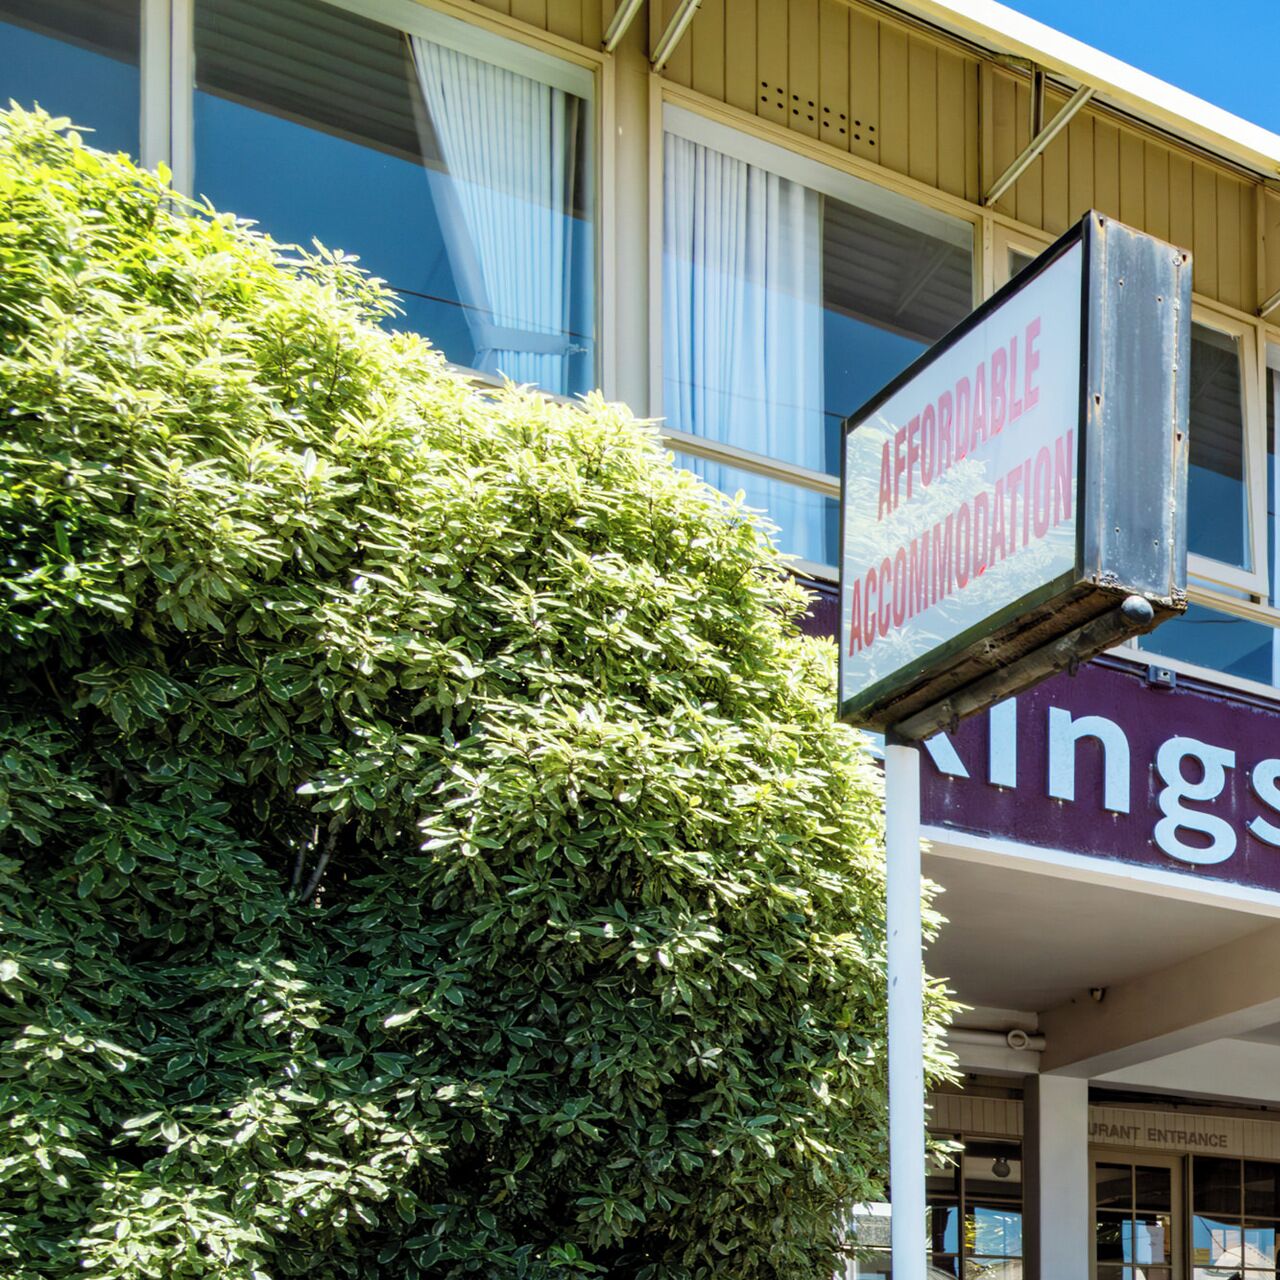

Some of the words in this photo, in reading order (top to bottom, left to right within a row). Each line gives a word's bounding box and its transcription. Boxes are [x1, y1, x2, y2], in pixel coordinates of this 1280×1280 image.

[877, 315, 1041, 523] AFFORDABLE
[848, 428, 1074, 658] ACCOMMODATION
[1147, 1127, 1228, 1148] ENTRANCE
